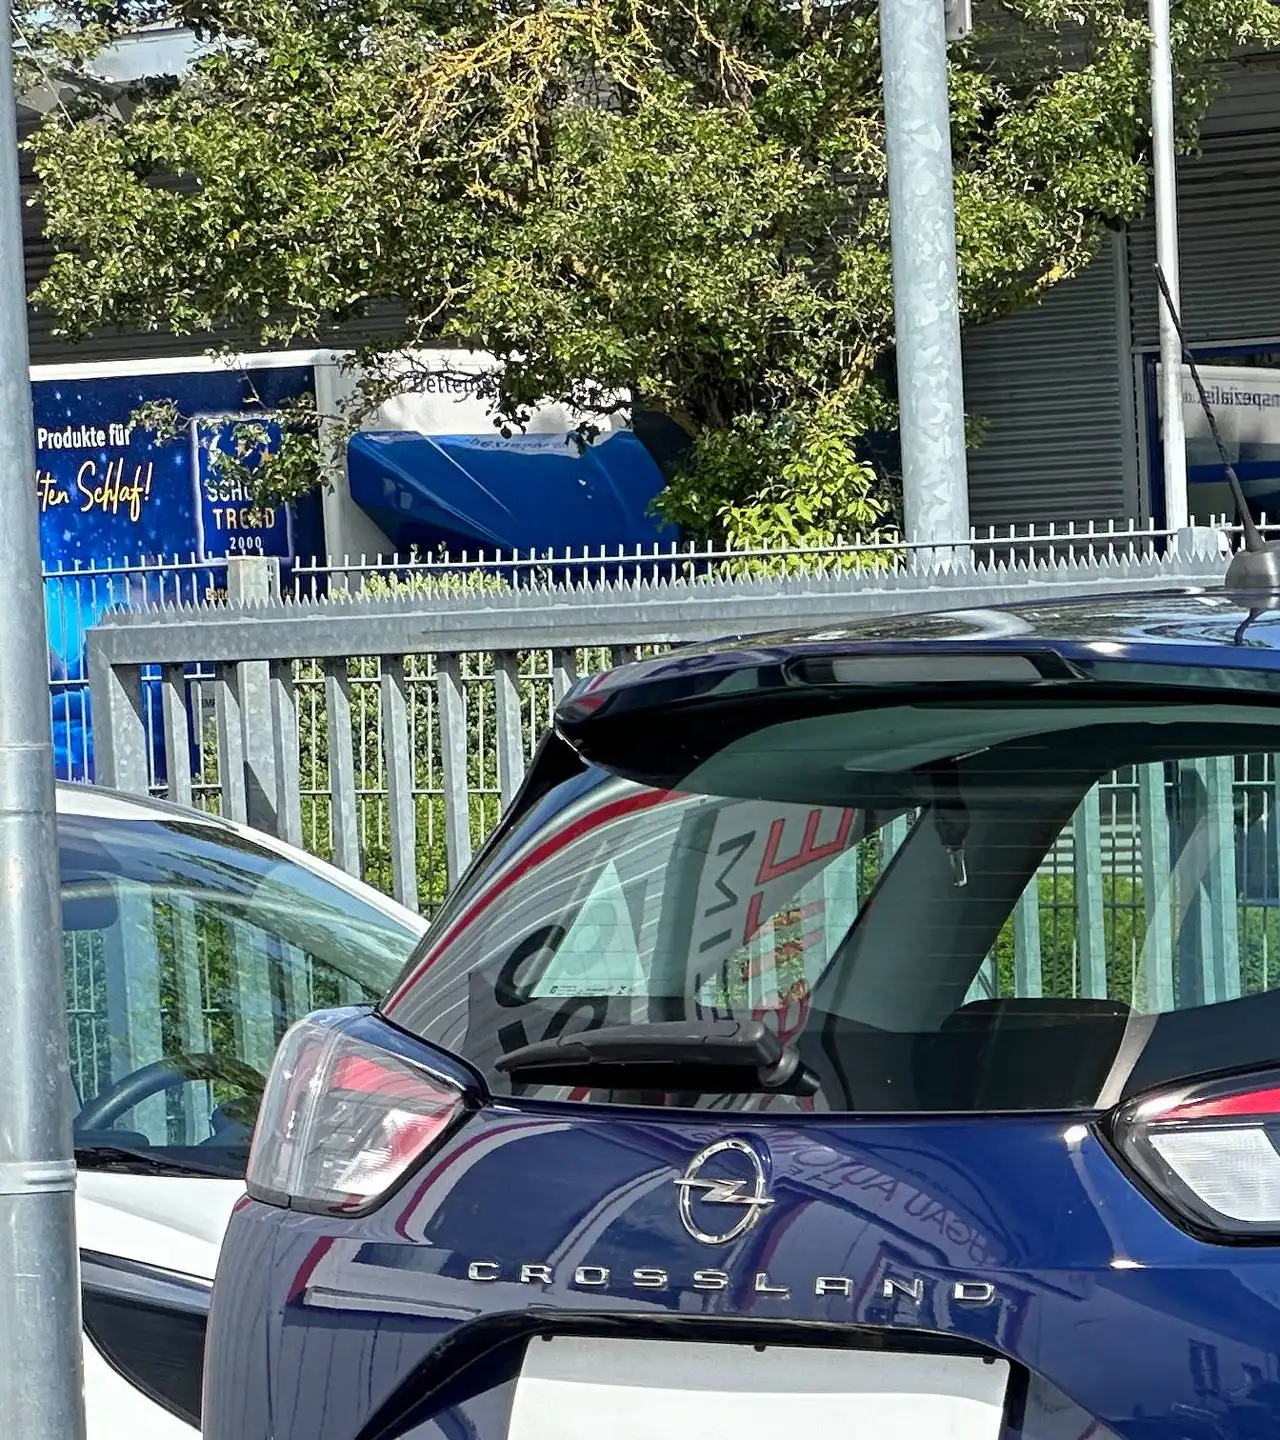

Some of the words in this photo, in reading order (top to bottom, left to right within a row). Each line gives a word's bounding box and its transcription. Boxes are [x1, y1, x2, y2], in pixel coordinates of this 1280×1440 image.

[38, 426, 105, 450] Produkte
[109, 423, 131, 446] für
[77, 457, 153, 522] Schlaf!
[229, 536, 262, 550] 2000
[467, 1261, 997, 1306] CROSSLAND
